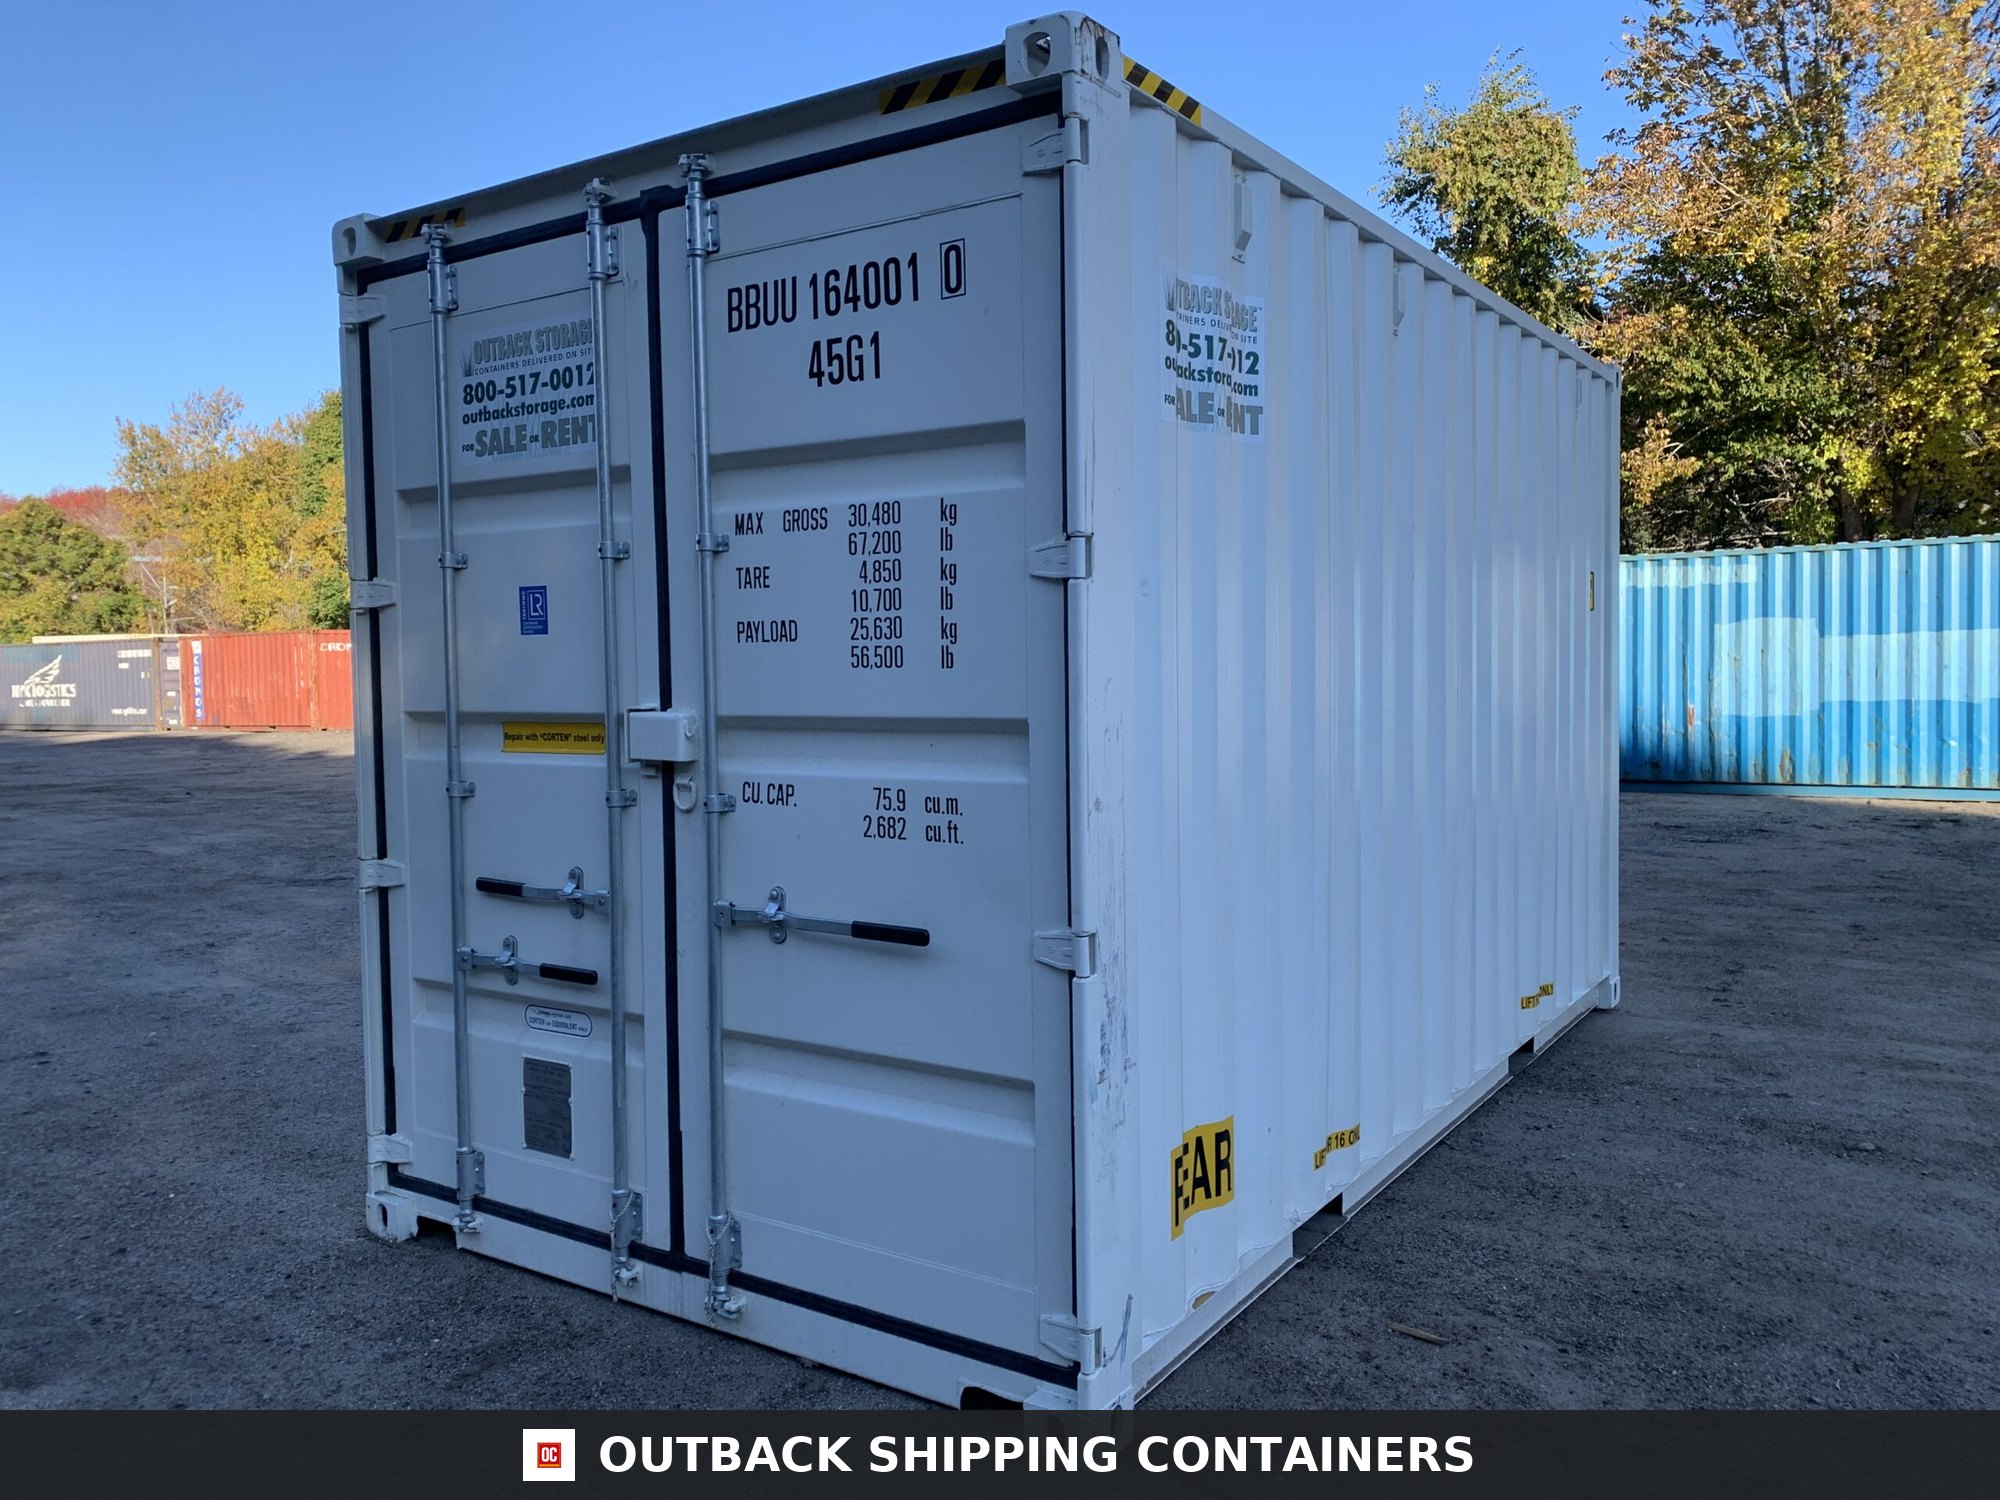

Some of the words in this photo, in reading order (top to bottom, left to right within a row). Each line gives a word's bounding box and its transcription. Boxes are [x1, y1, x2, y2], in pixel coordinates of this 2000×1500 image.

[727, 275, 797, 333] BBUU
[809, 252, 919, 320] 164001
[943, 243, 963, 295] 0
[1176, 279, 1222, 317] TBACK
[1176, 312, 1206, 327] TAINERS
[1210, 319, 1233, 333] DELIVE
[1240, 336, 1258, 345] SITE
[473, 330, 532, 364] OUTBACK
[474, 361, 519, 375] CONTAINERS
[522, 353, 563, 367] DELIVERED
[566, 351, 577, 359] ON
[580, 347, 592, 356] SIT
[808, 330, 881, 388] 45G1
[1165, 319, 1260, 375] 8-517-12
[463, 362, 594, 405] 800-517-0012
[1164, 394, 1175, 406] FOR
[1176, 387, 1215, 424] ALE
[462, 443, 474, 453] FOR
[474, 424, 527, 458] SALE
[529, 434, 539, 443] OR
[541, 414, 596, 449] RENT
[734, 512, 764, 536] MAX
[783, 507, 828, 532] GROSS
[848, 500, 901, 527] 30,480
[940, 498, 958, 526] kg
[849, 530, 901, 556] 67,200
[940, 527, 954, 551] lb
[735, 566, 771, 590] TARE
[859, 558, 902, 585] 4,850
[940, 557, 958, 585] kg
[851, 587, 902, 613] 10,700
[940, 587, 954, 611] lb
[737, 620, 798, 643] PAYLOAD
[850, 615, 903, 641] 25,630
[941, 616, 958, 644] kg
[851, 645, 904, 670] 56,500
[941, 645, 955, 669] lb
[504, 732, 524, 743] Repair
[525, 732, 538, 741] with
[573, 733, 589, 742] steel
[590, 734, 605, 744] only
[873, 787, 906, 812] 75.9
[925, 796, 964, 816] cu.m.
[863, 814, 907, 840] 2,682
[925, 820, 964, 845] cu.ft.
[1315, 1149, 1326, 1169] LIF
[1174, 1128, 1232, 1228] RAR
